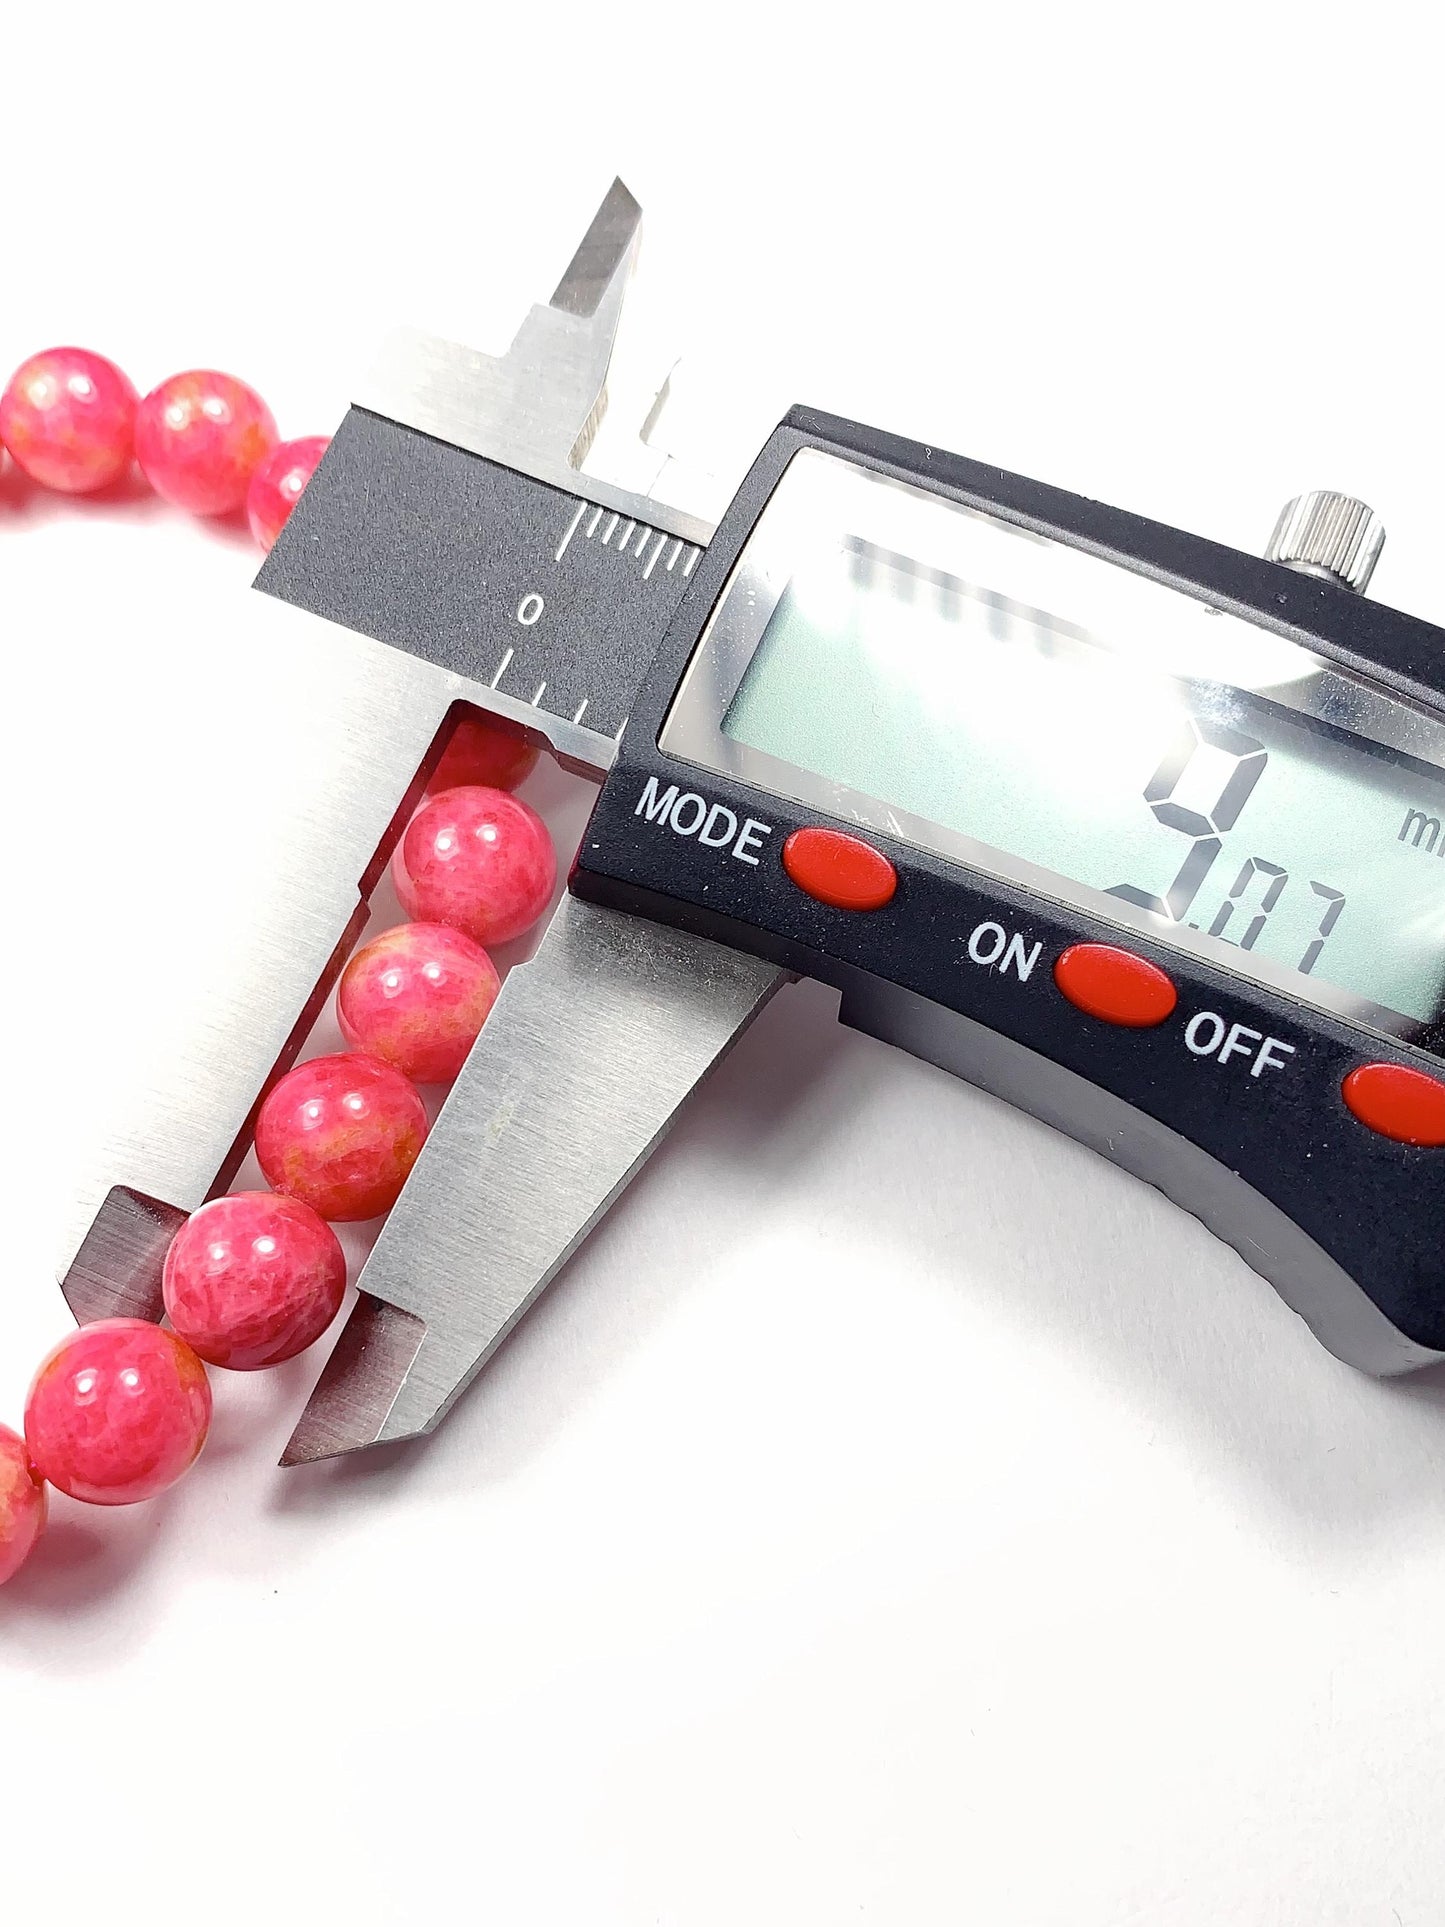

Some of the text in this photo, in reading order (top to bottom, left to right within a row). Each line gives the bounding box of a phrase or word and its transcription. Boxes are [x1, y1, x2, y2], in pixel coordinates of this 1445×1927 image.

[517, 593, 545, 625] 0
[634, 776, 772, 866] MODE
[1397, 807, 1445, 858] m
[968, 921, 1043, 982] ON
[1184, 1011, 1296, 1078] OFF
